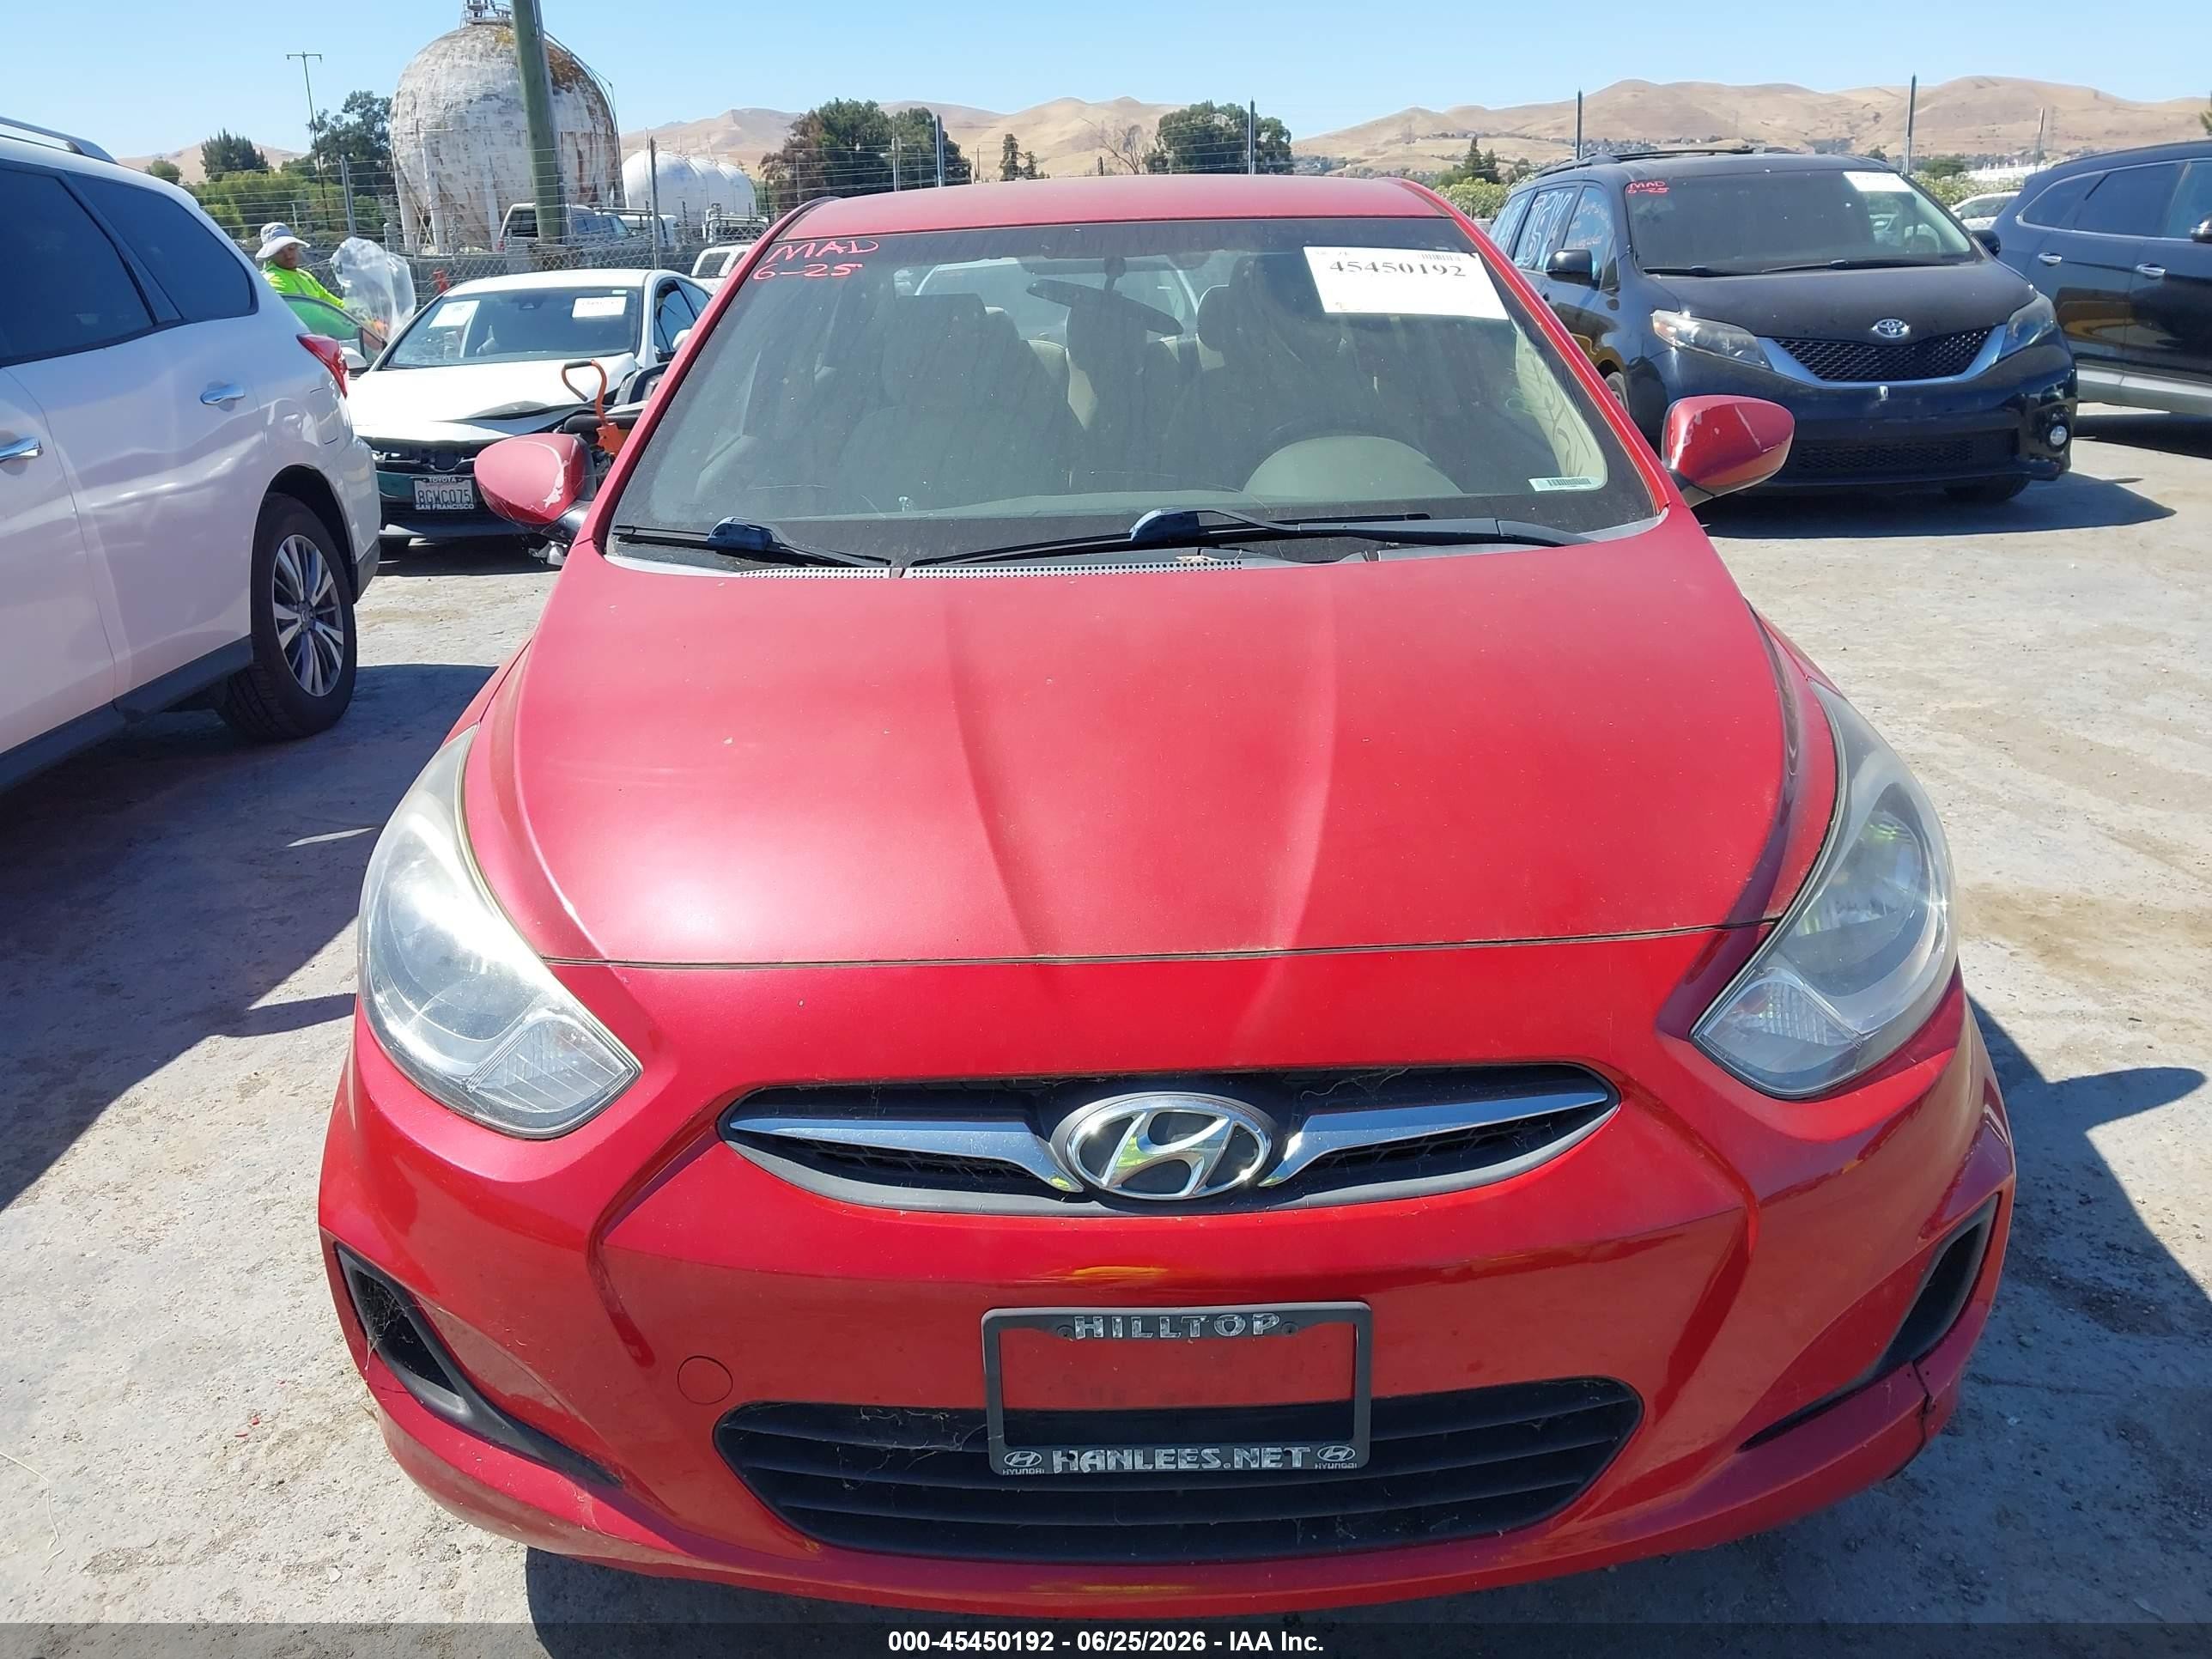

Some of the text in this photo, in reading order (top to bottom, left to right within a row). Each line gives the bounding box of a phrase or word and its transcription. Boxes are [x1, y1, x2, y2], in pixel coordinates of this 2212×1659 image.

[765, 240, 879, 264] MAD
[752, 263, 864, 280] 6-25
[1329, 260, 1467, 277] 45450192
[1073, 1312, 1280, 1340] HILLTOP
[1052, 1446, 1310, 1474] HANLEES.NET
